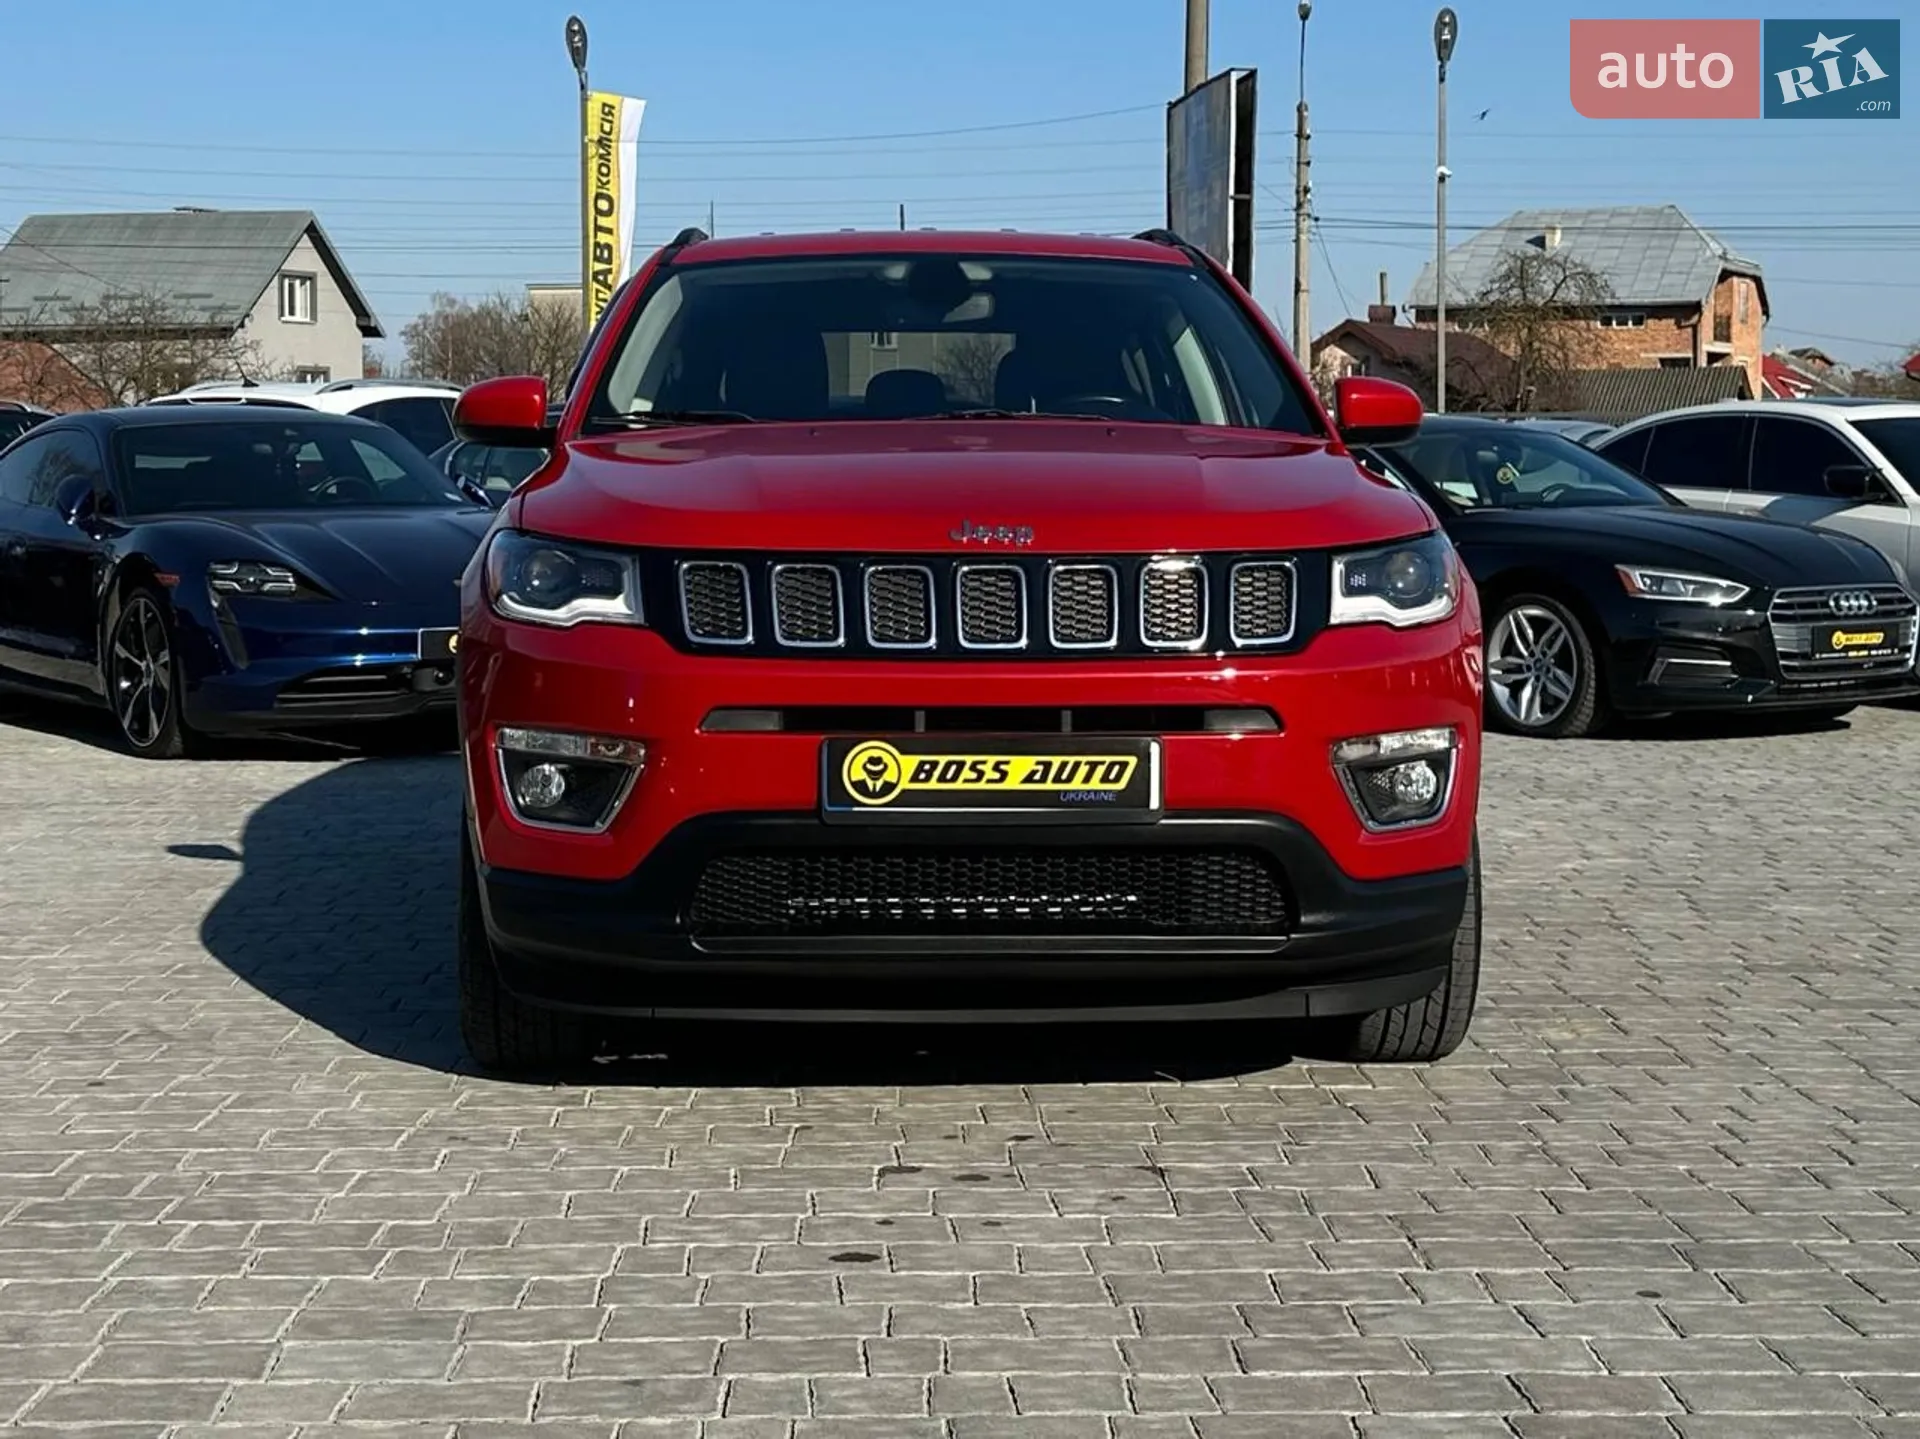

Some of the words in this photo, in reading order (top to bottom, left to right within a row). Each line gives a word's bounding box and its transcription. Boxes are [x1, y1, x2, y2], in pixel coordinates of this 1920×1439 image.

[949, 519, 1034, 546] Jeep
[909, 760, 1011, 784] BOSS
[1020, 760, 1130, 784] AUTO
[1060, 790, 1116, 802] UKRAINE
